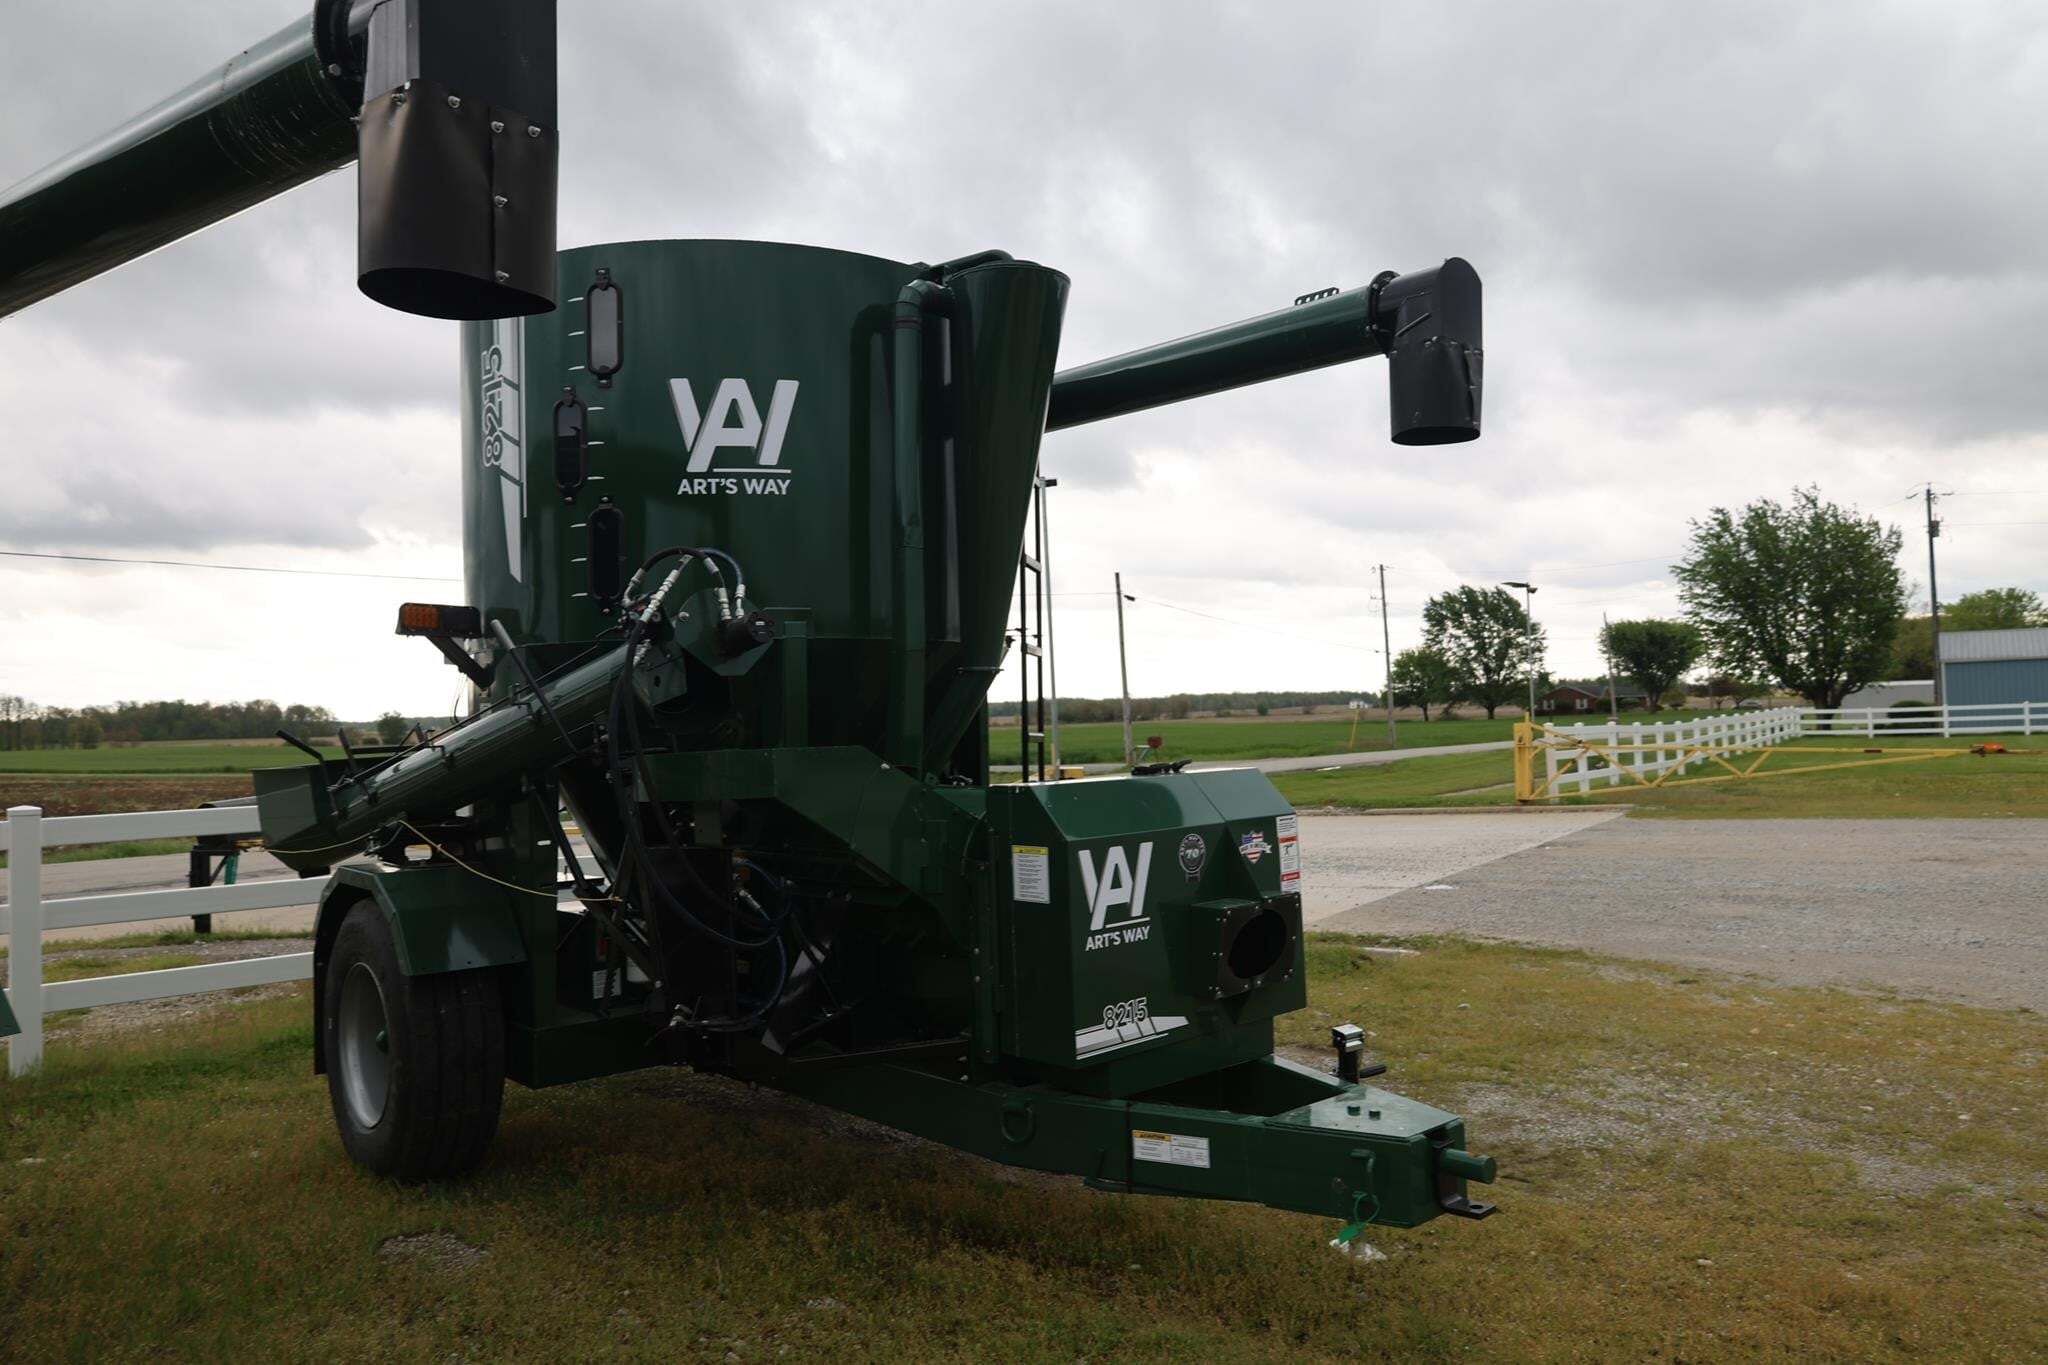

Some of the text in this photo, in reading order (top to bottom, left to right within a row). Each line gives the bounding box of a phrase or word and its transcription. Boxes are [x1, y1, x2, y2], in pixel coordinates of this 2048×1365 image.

[481, 345, 503, 467] 8215
[677, 478, 792, 496] ART'S WAY
[1085, 925, 1151, 952] ART'S WAY
[1103, 996, 1149, 1031] 8215
